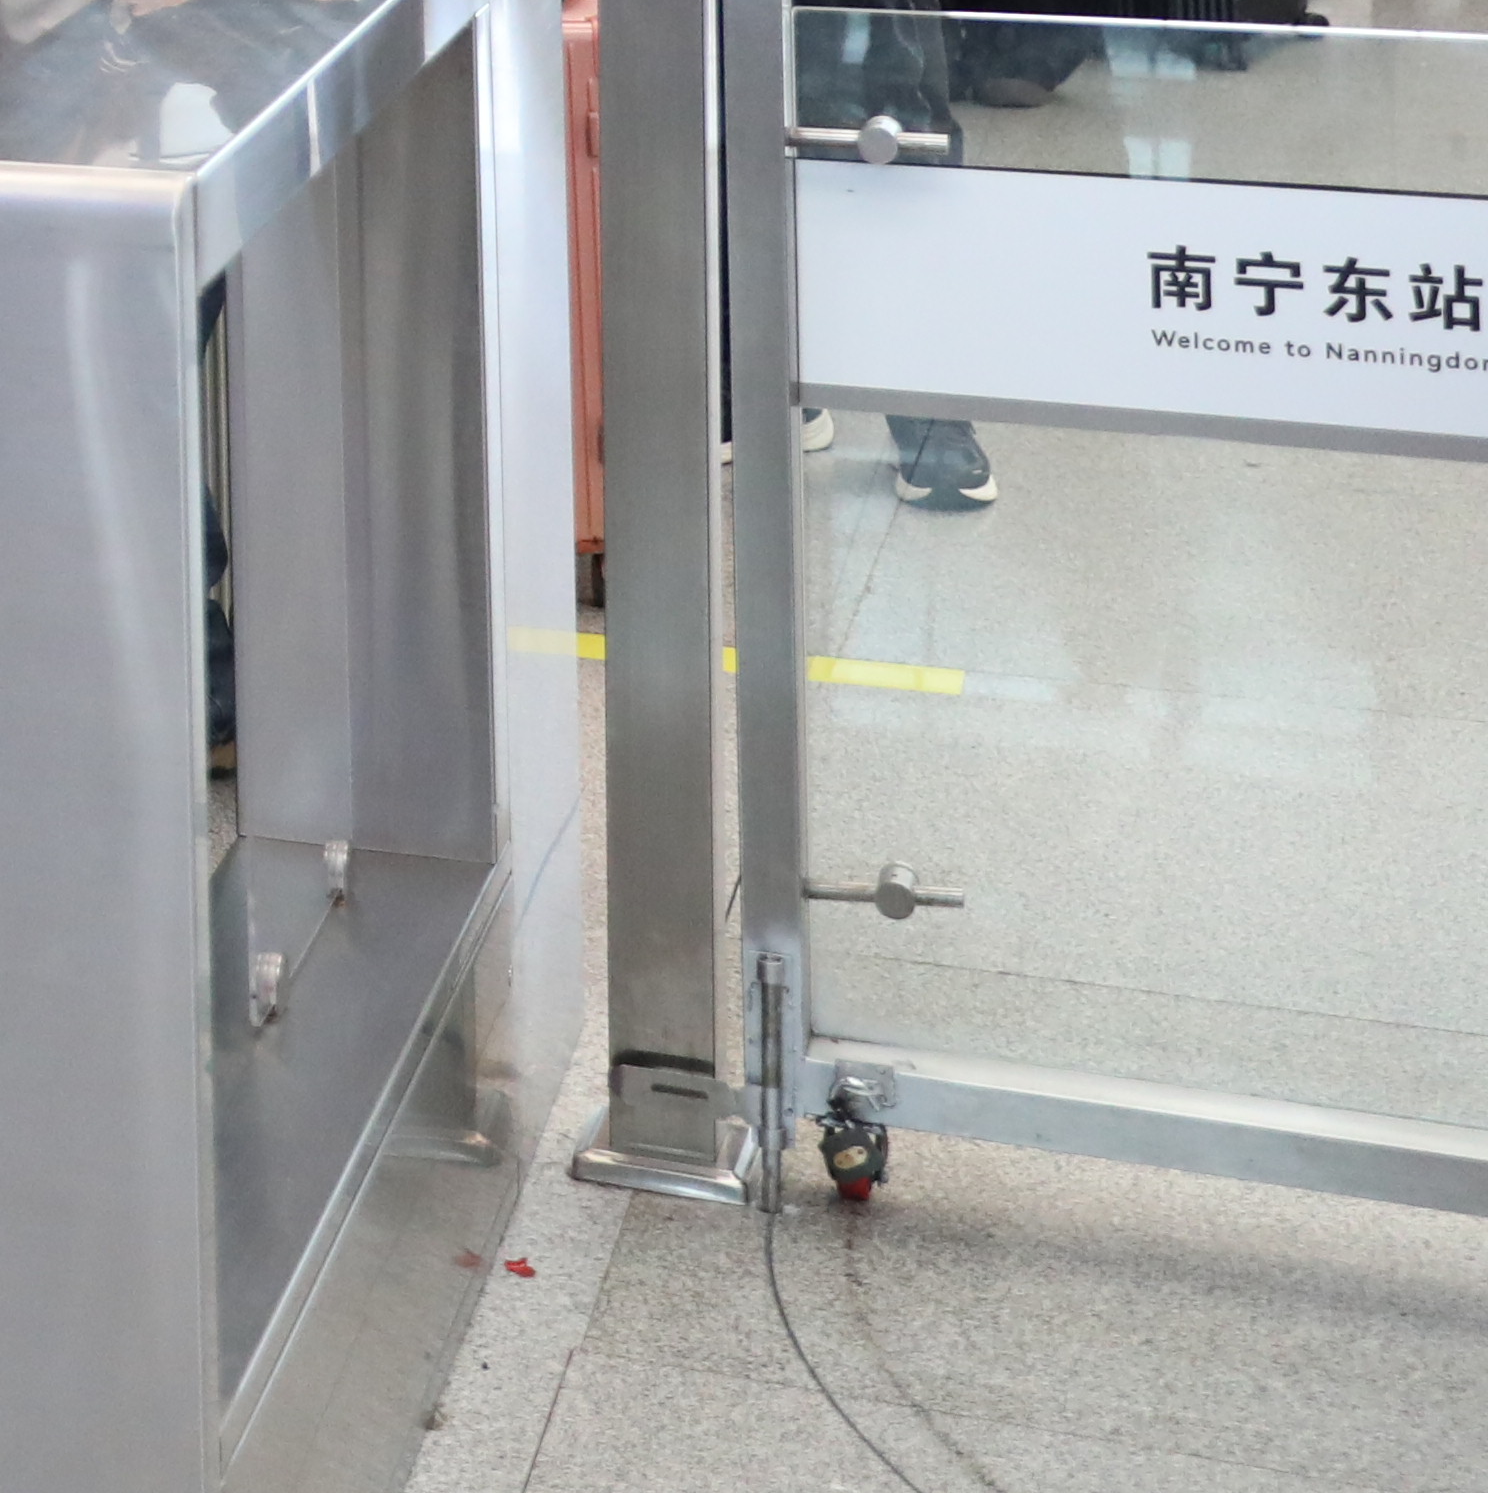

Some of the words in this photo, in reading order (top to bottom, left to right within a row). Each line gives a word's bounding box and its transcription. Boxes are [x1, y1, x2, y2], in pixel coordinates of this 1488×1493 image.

[1147, 244, 1484, 332] 南宁东站
[1152, 328, 1272, 356] Welcome
[1285, 340, 1312, 358] to
